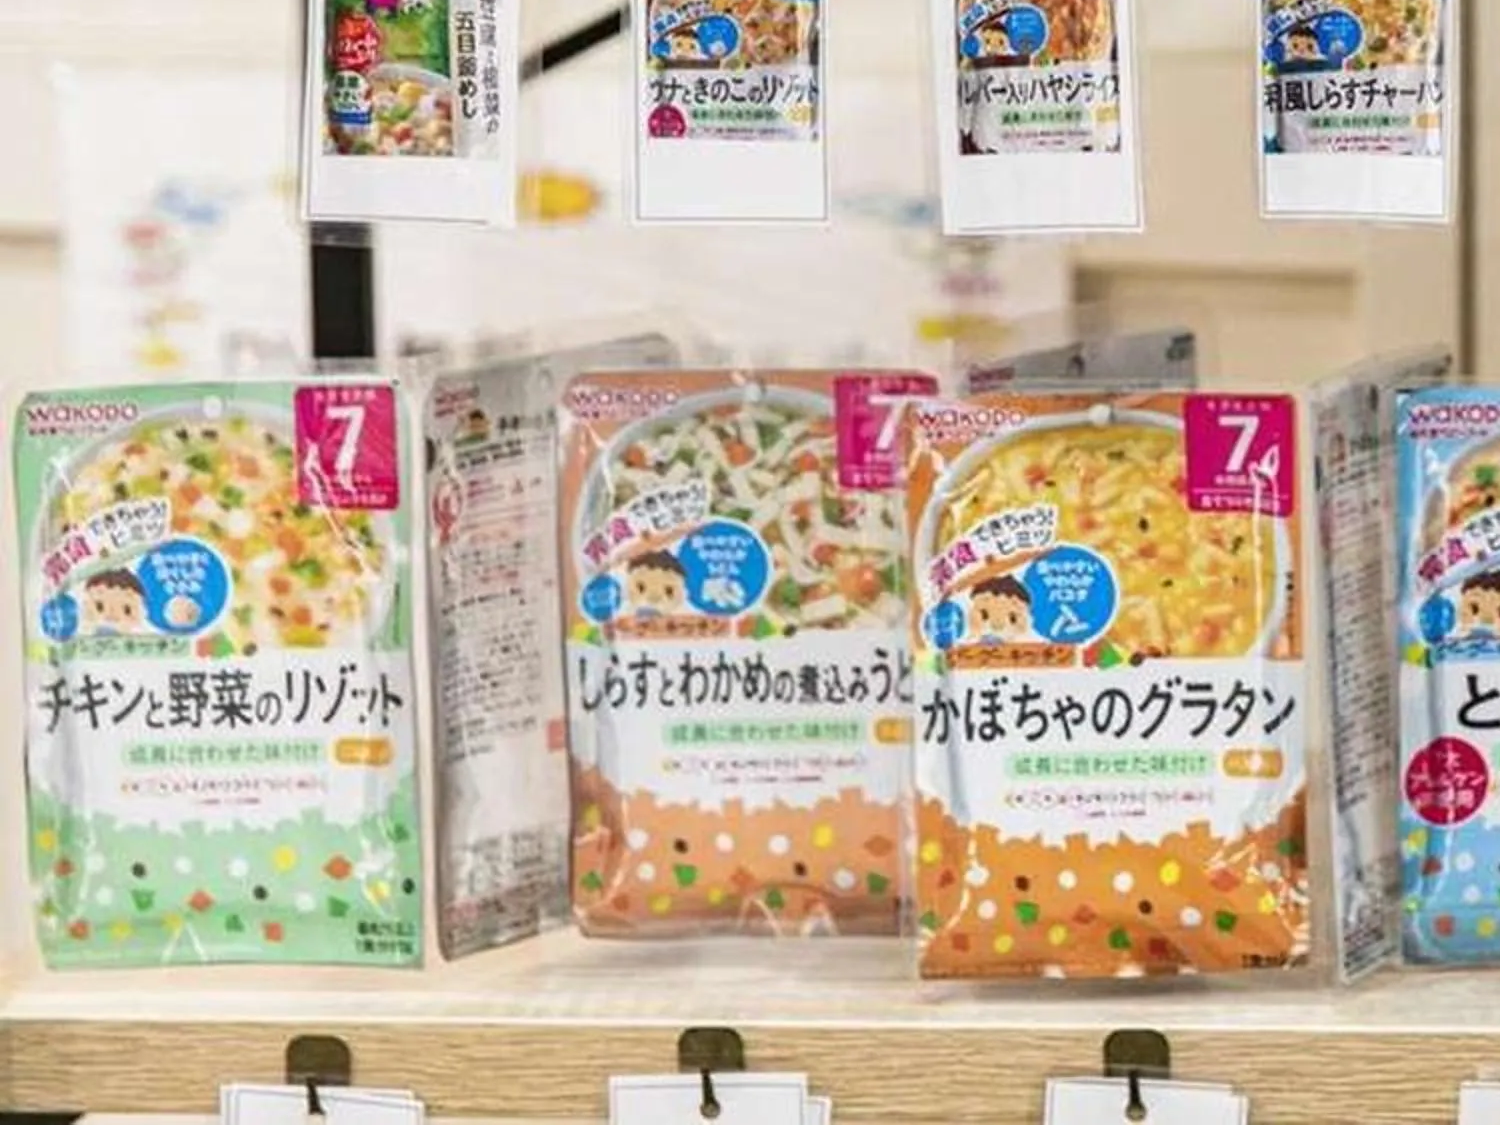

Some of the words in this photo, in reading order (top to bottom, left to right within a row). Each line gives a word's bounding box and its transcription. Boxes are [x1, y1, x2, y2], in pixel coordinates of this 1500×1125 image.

[325, 406, 366, 475] 7
[1217, 414, 1261, 474] 7
[972, 507, 1055, 544] できちゃう!
[996, 526, 1053, 556] ヒミツ
[38, 663, 402, 734] チキンと野菜のリゾット
[922, 675, 1297, 745] かぼちゃのグラタン
[1014, 755, 1207, 776] 成長に合わせた味付け
